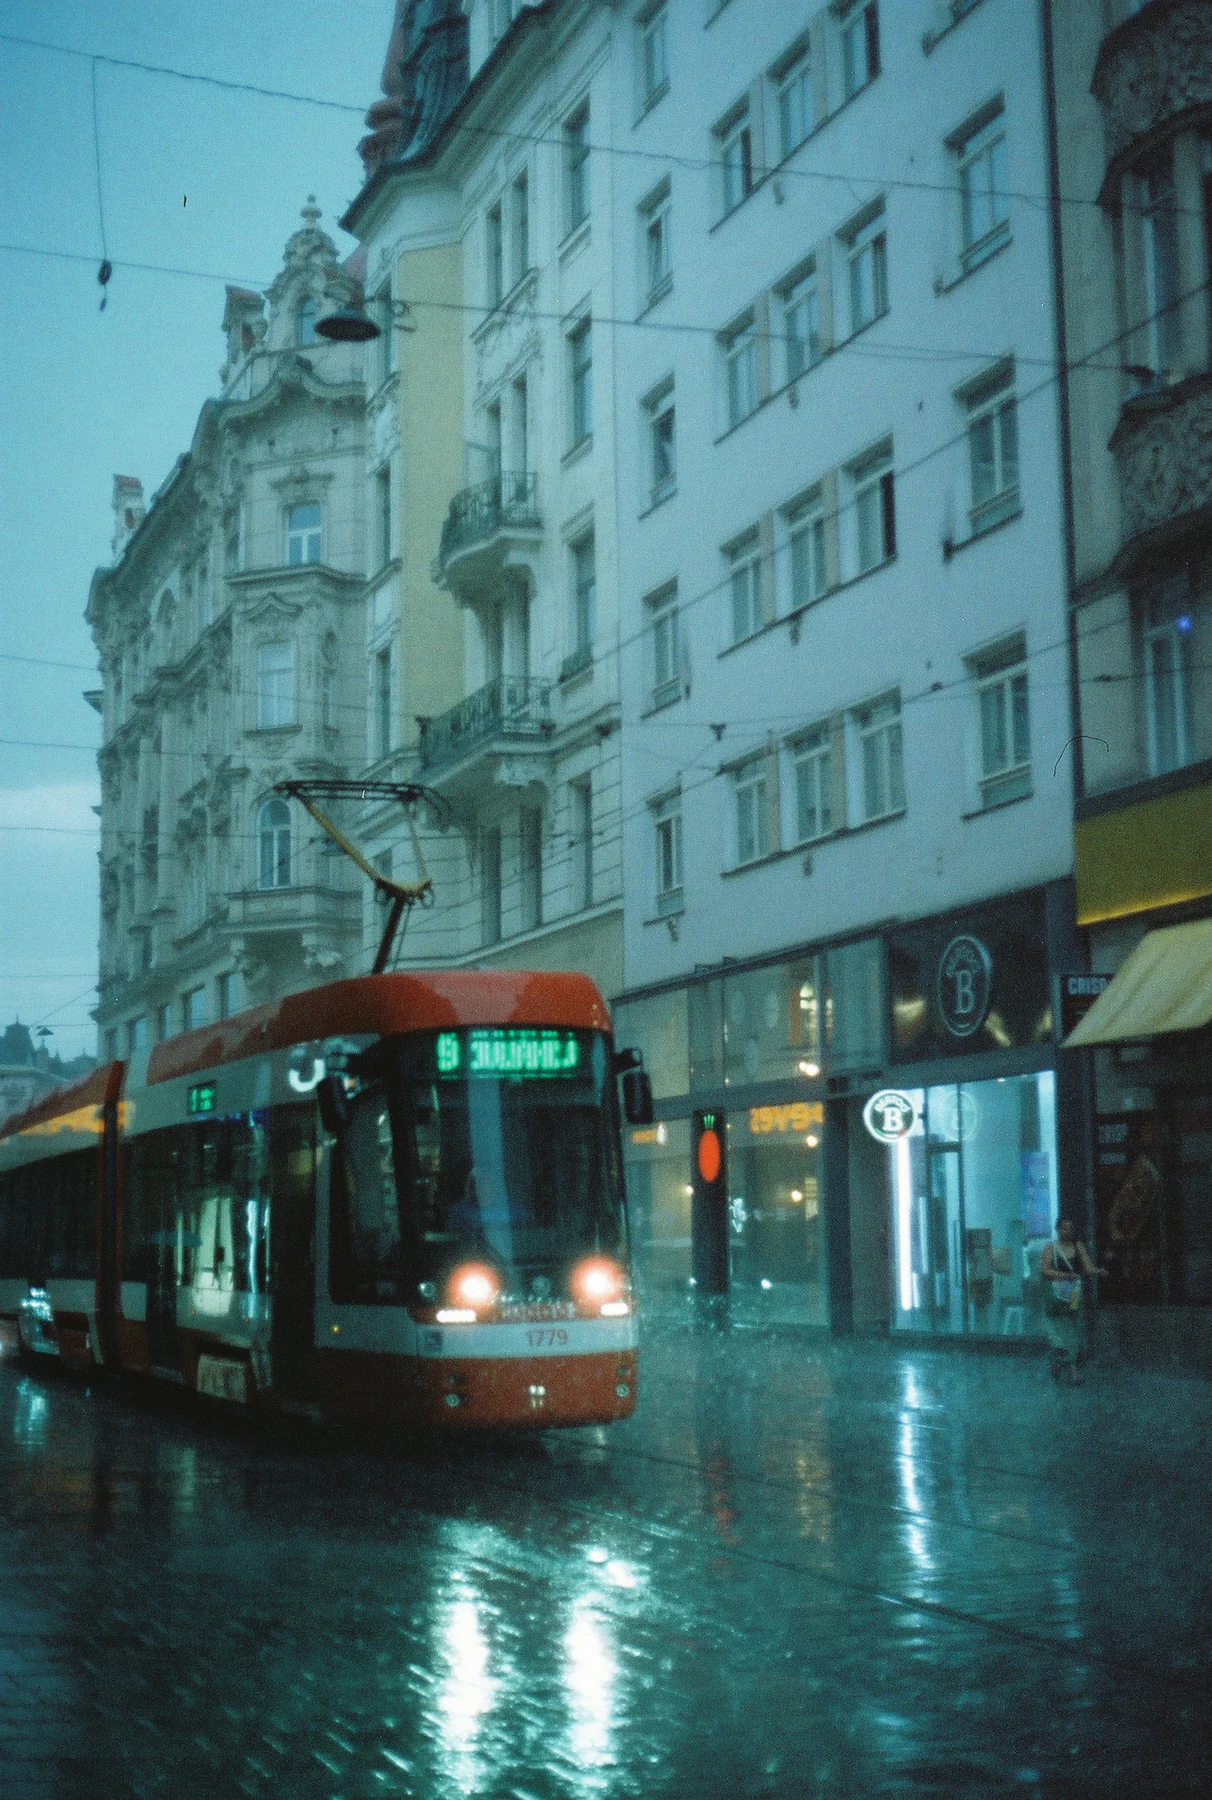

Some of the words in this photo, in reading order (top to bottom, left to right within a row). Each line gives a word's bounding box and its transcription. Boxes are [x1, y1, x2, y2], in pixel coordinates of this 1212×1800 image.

[954, 969, 976, 1013] B
[882, 1107, 904, 1131] B
[525, 1329, 569, 1347] 1779
